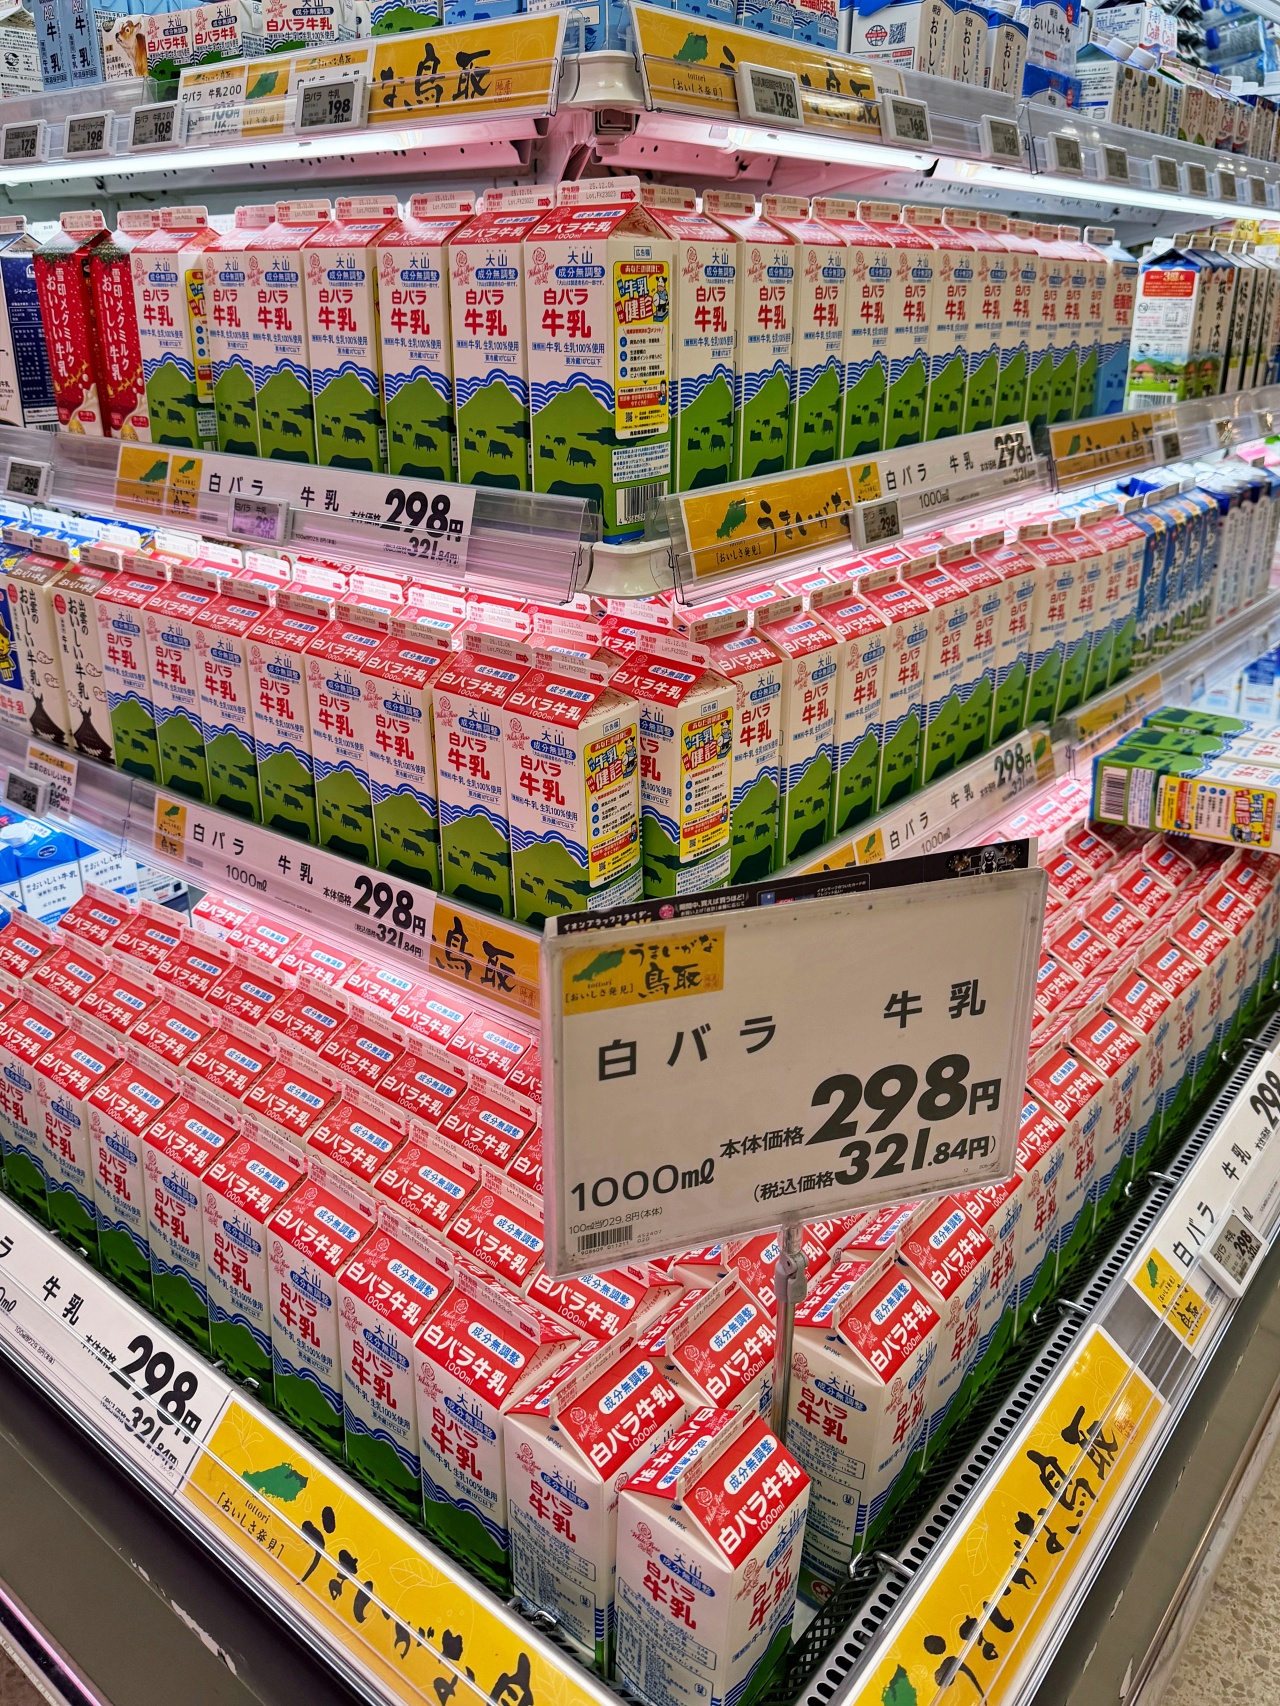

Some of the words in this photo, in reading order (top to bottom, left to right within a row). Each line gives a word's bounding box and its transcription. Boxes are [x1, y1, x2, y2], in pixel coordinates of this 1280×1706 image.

[216, 4, 232, 19] 大山
[265, 17, 333, 32] 白バラ牛乳
[194, 26, 238, 45] 白バラ牛乳
[1032, 15, 1071, 44] おいしい牛乳
[182, 90, 203, 103] 白バラ
[208, 84, 243, 99] 牛乳200
[303, 91, 323, 103] 白バラ
[327, 89, 341, 99] 牛乳
[327, 99, 351, 116] 198
[773, 91, 794, 109] 178
[87, 130, 103, 143] 198
[153, 120, 172, 136] 108
[909, 117, 925, 133] 168
[21, 138, 36, 151] 178
[533, 220, 612, 236] 白バラ牛乳
[574, 209, 624, 219] 成分無調整
[142, 288, 170, 302] 白バラ
[543, 287, 589, 306] 白バラ
[624, 296, 654, 321] 健診
[759, 285, 786, 302] 白バラ
[45, 272, 70, 379] おいしい牛乳
[55, 266, 76, 368] 雪印メグミルク
[101, 271, 124, 382] おいしい牛乳
[111, 267, 130, 372] 雪印メグミルク
[142, 304, 174, 328] 牛乳
[257, 306, 292, 331] 牛乳
[317, 306, 357, 333] 牛乳
[541, 308, 592, 338] 牛乳
[757, 305, 787, 331] 牛乳
[563, 342, 606, 354] 生乳100%使用
[208, 472, 264, 496] 白バラ
[885, 461, 927, 492] 白バラ
[949, 449, 975, 475] 牛乳
[300, 485, 340, 513] 牛乳
[255, 515, 276, 531] 298
[379, 487, 464, 543] 298円
[879, 514, 898, 532] 298
[28, 588, 40, 625] 出雲の
[77, 599, 90, 636] 出雲の
[19, 586, 42, 687] おいしい牛乳
[66, 596, 90, 701] おいしい牛乳
[107, 632, 133, 648] 白バラ
[107, 648, 137, 670] 牛乳
[366, 656, 426, 682] 白バラ牛乳
[855, 665, 878, 685] 白バラ
[509, 692, 580, 722] 白バラ牛乳
[548, 684, 593, 702] 成分無調整
[318, 708, 354, 738] 牛乳
[520, 755, 562, 777] 白バラ
[594, 764, 623, 792] 健診
[993, 742, 1033, 788] 298円
[889, 810, 929, 851] 白バラ
[949, 783, 975, 809] 牛乳
[193, 823, 245, 856] 白バラ
[277, 854, 314, 886] 牛乳
[31, 870, 78, 891] おいしい牛乳
[322, 886, 352, 906] 本体価格
[352, 874, 427, 938] 298円
[432, 915, 518, 993] 鳥取
[628, 933, 720, 957] うまいがな
[587, 980, 614, 991] tottori
[637, 964, 704, 999] 鳥取
[598, 1015, 778, 1082] 白バラ
[882, 978, 987, 1030] 牛乳
[226, 1049, 261, 1072] 成分無調整
[452, 1034, 511, 1073] 白バラ牛乳
[1095, 1031, 1135, 1070] 白バラ牛乳
[191, 1051, 251, 1091] 白バラ牛乳
[719, 1126, 805, 1161] 本体価格
[806, 1052, 1002, 1147] 298円
[443, 1114, 511, 1160] 白バラ牛乳
[481, 1113, 521, 1139] 成分無調整
[753, 1170, 836, 1204] (税込価格
[834, 1126, 997, 1187] 321.84円)
[1172, 1201, 1215, 1269] 白バラ
[1221, 1141, 1252, 1182] 牛乳
[214, 1232, 249, 1264] 白バラ
[1232, 1229, 1254, 1255] 298
[214, 1249, 252, 1294] 牛乳
[389, 1259, 438, 1300] 成分無調整
[41, 1274, 85, 1326] 牛乳
[867, 1300, 933, 1373] 白バラ牛乳
[108, 1334, 203, 1445] 298円
[600, 1361, 653, 1413] 成分無調整
[801, 1386, 849, 1421] 白バラ
[589, 1382, 677, 1469] 白バラ牛乳
[795, 1399, 849, 1446] 牛乳
[243, 1496, 272, 1526] tottori
[717, 1460, 801, 1556] 白バラ牛乳
[756, 1501, 786, 1536] 1000ml
[642, 1578, 697, 1631] 牛乳
